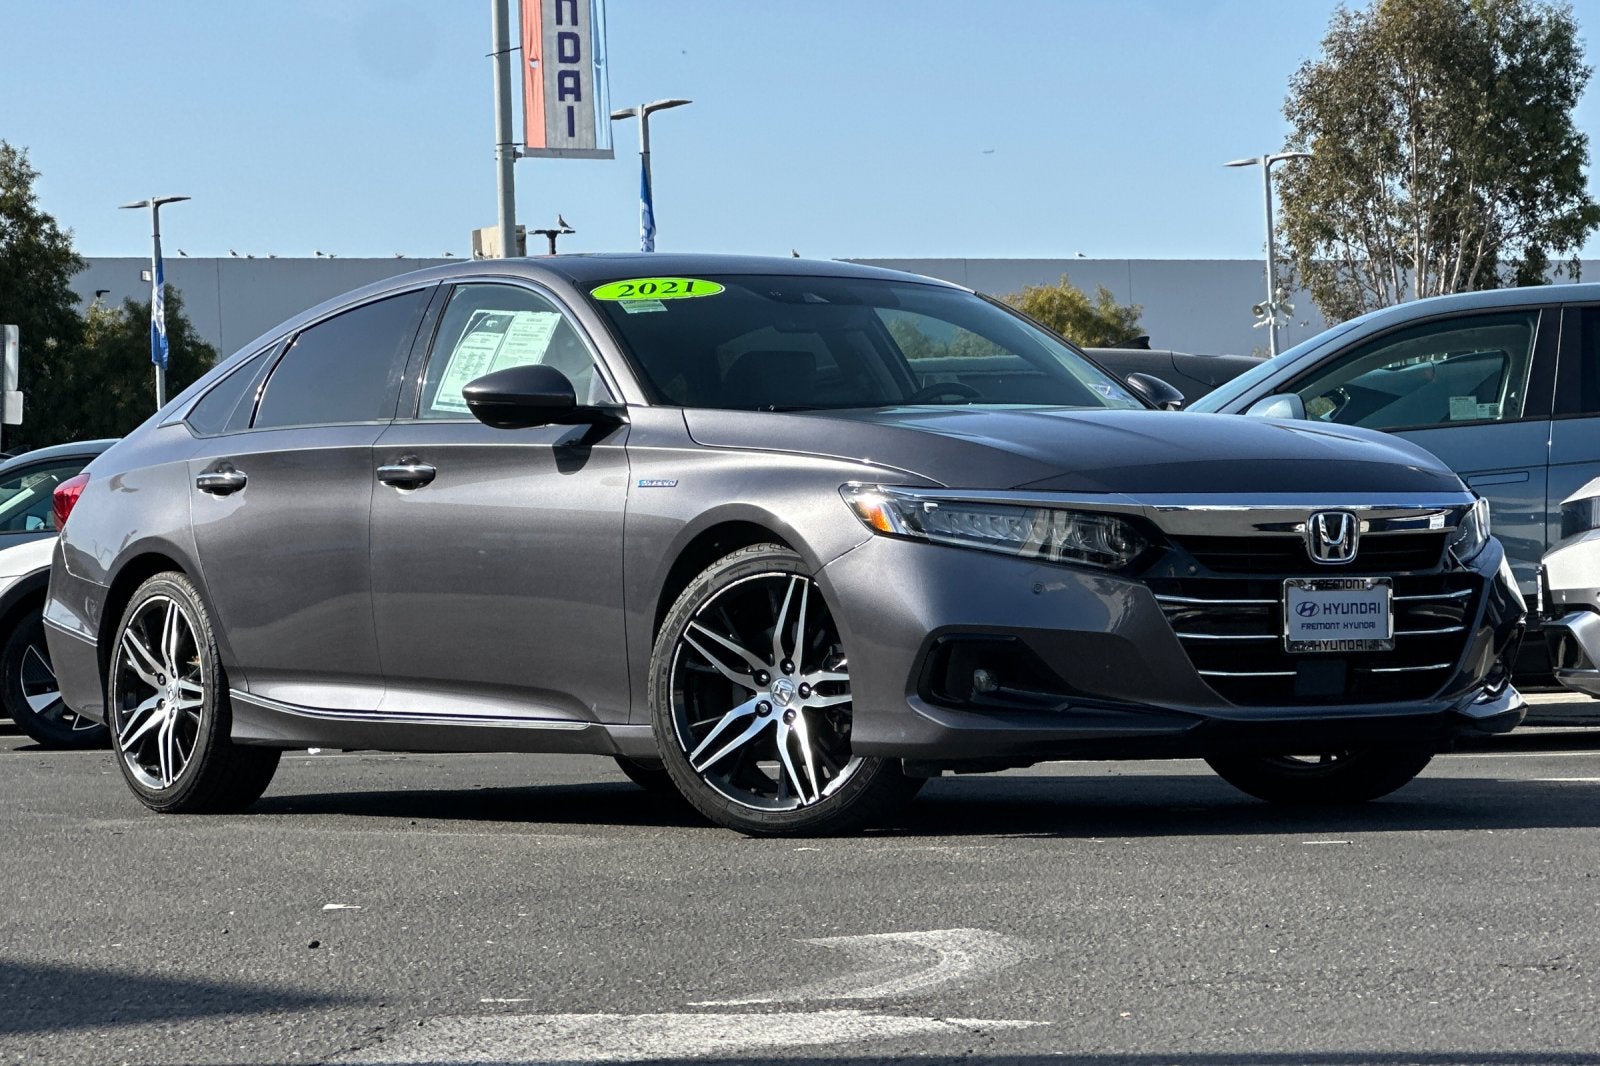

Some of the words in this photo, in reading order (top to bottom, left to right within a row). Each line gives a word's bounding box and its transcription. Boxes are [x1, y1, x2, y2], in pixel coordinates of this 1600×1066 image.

[617, 281, 695, 298] 2021
[1310, 579, 1367, 590] FREMONT
[1323, 602, 1381, 615] HYUNDAI
[1301, 622, 1340, 631] FREMONT
[1343, 621, 1376, 630] HYUNDAI
[1313, 640, 1368, 651] HYUNDAI
